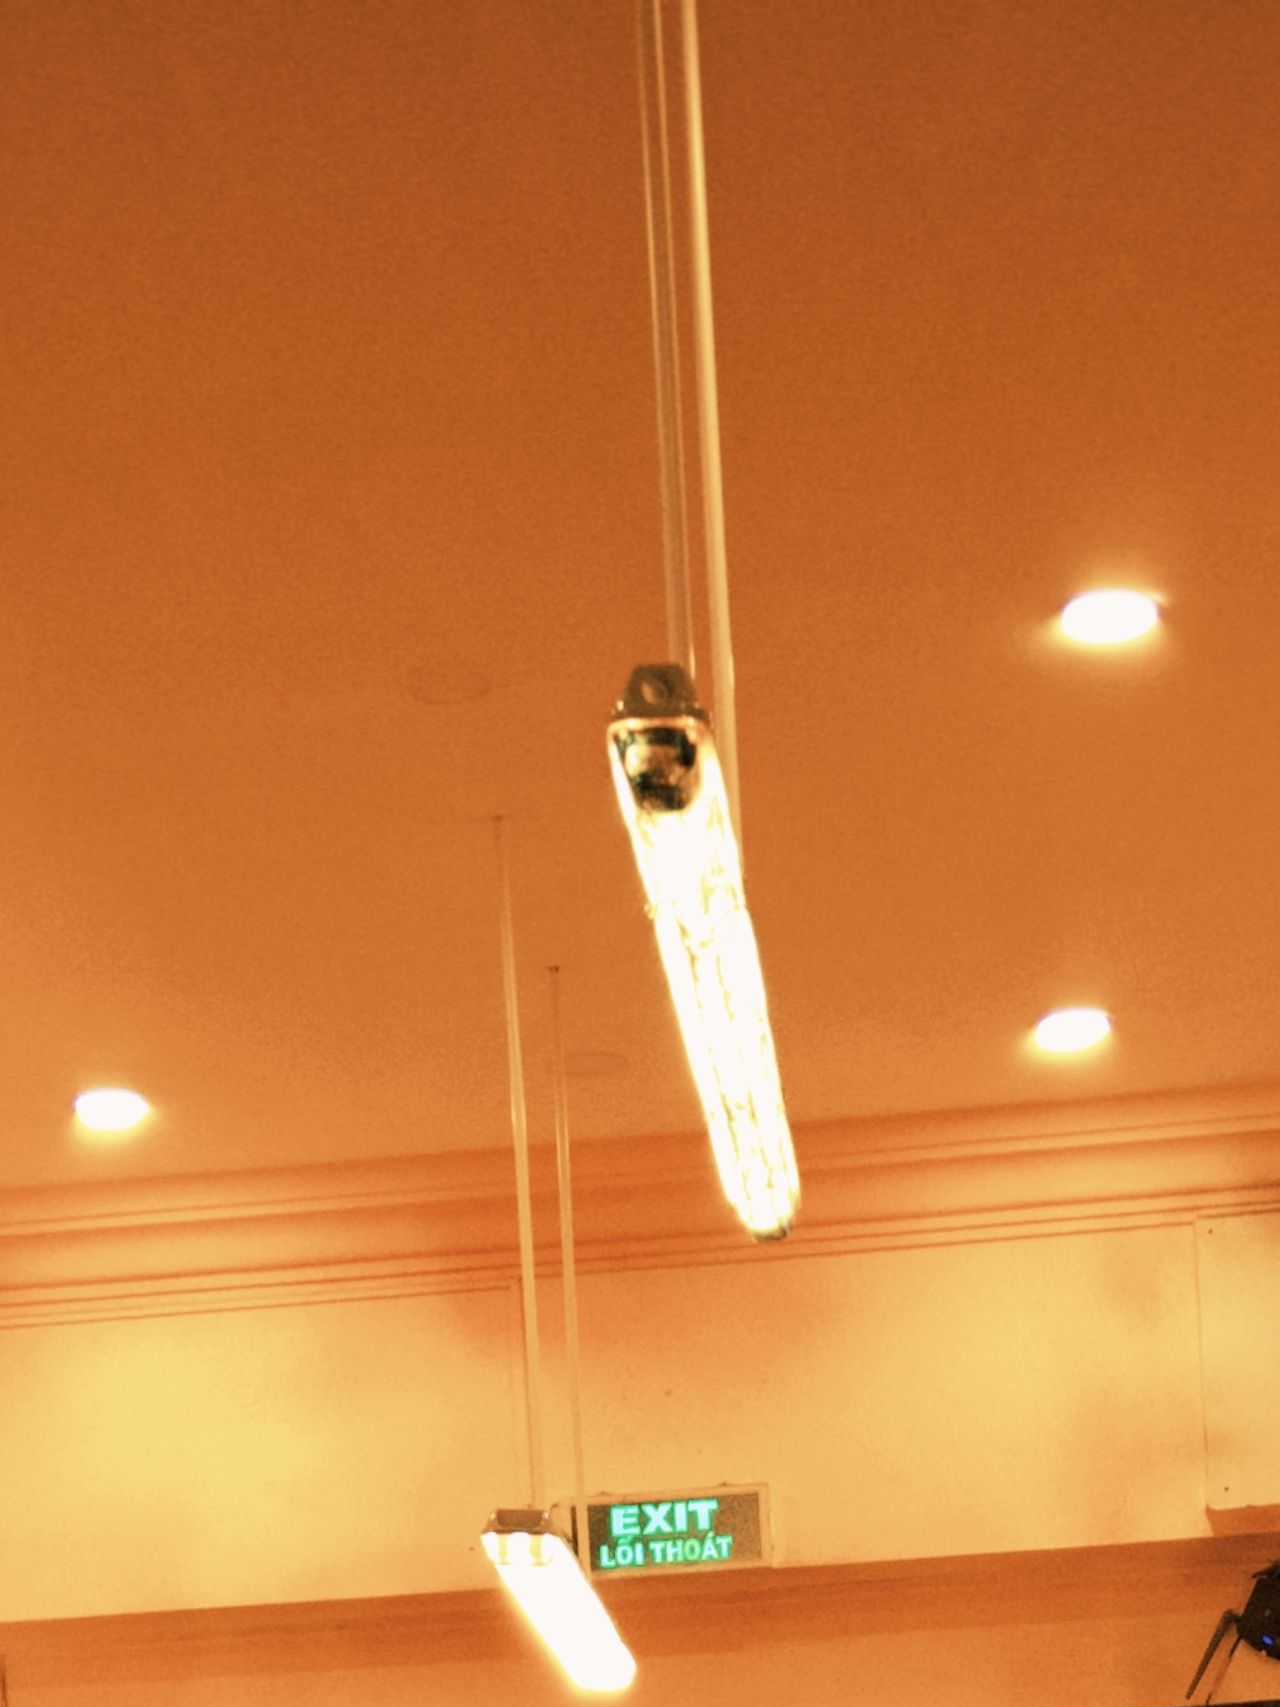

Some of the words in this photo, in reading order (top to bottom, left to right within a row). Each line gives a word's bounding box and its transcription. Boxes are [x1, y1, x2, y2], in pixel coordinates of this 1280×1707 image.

[610, 1498, 718, 1536] EXIT
[600, 1535, 644, 1569] LỐI
[650, 1531, 733, 1563] THOÁT
